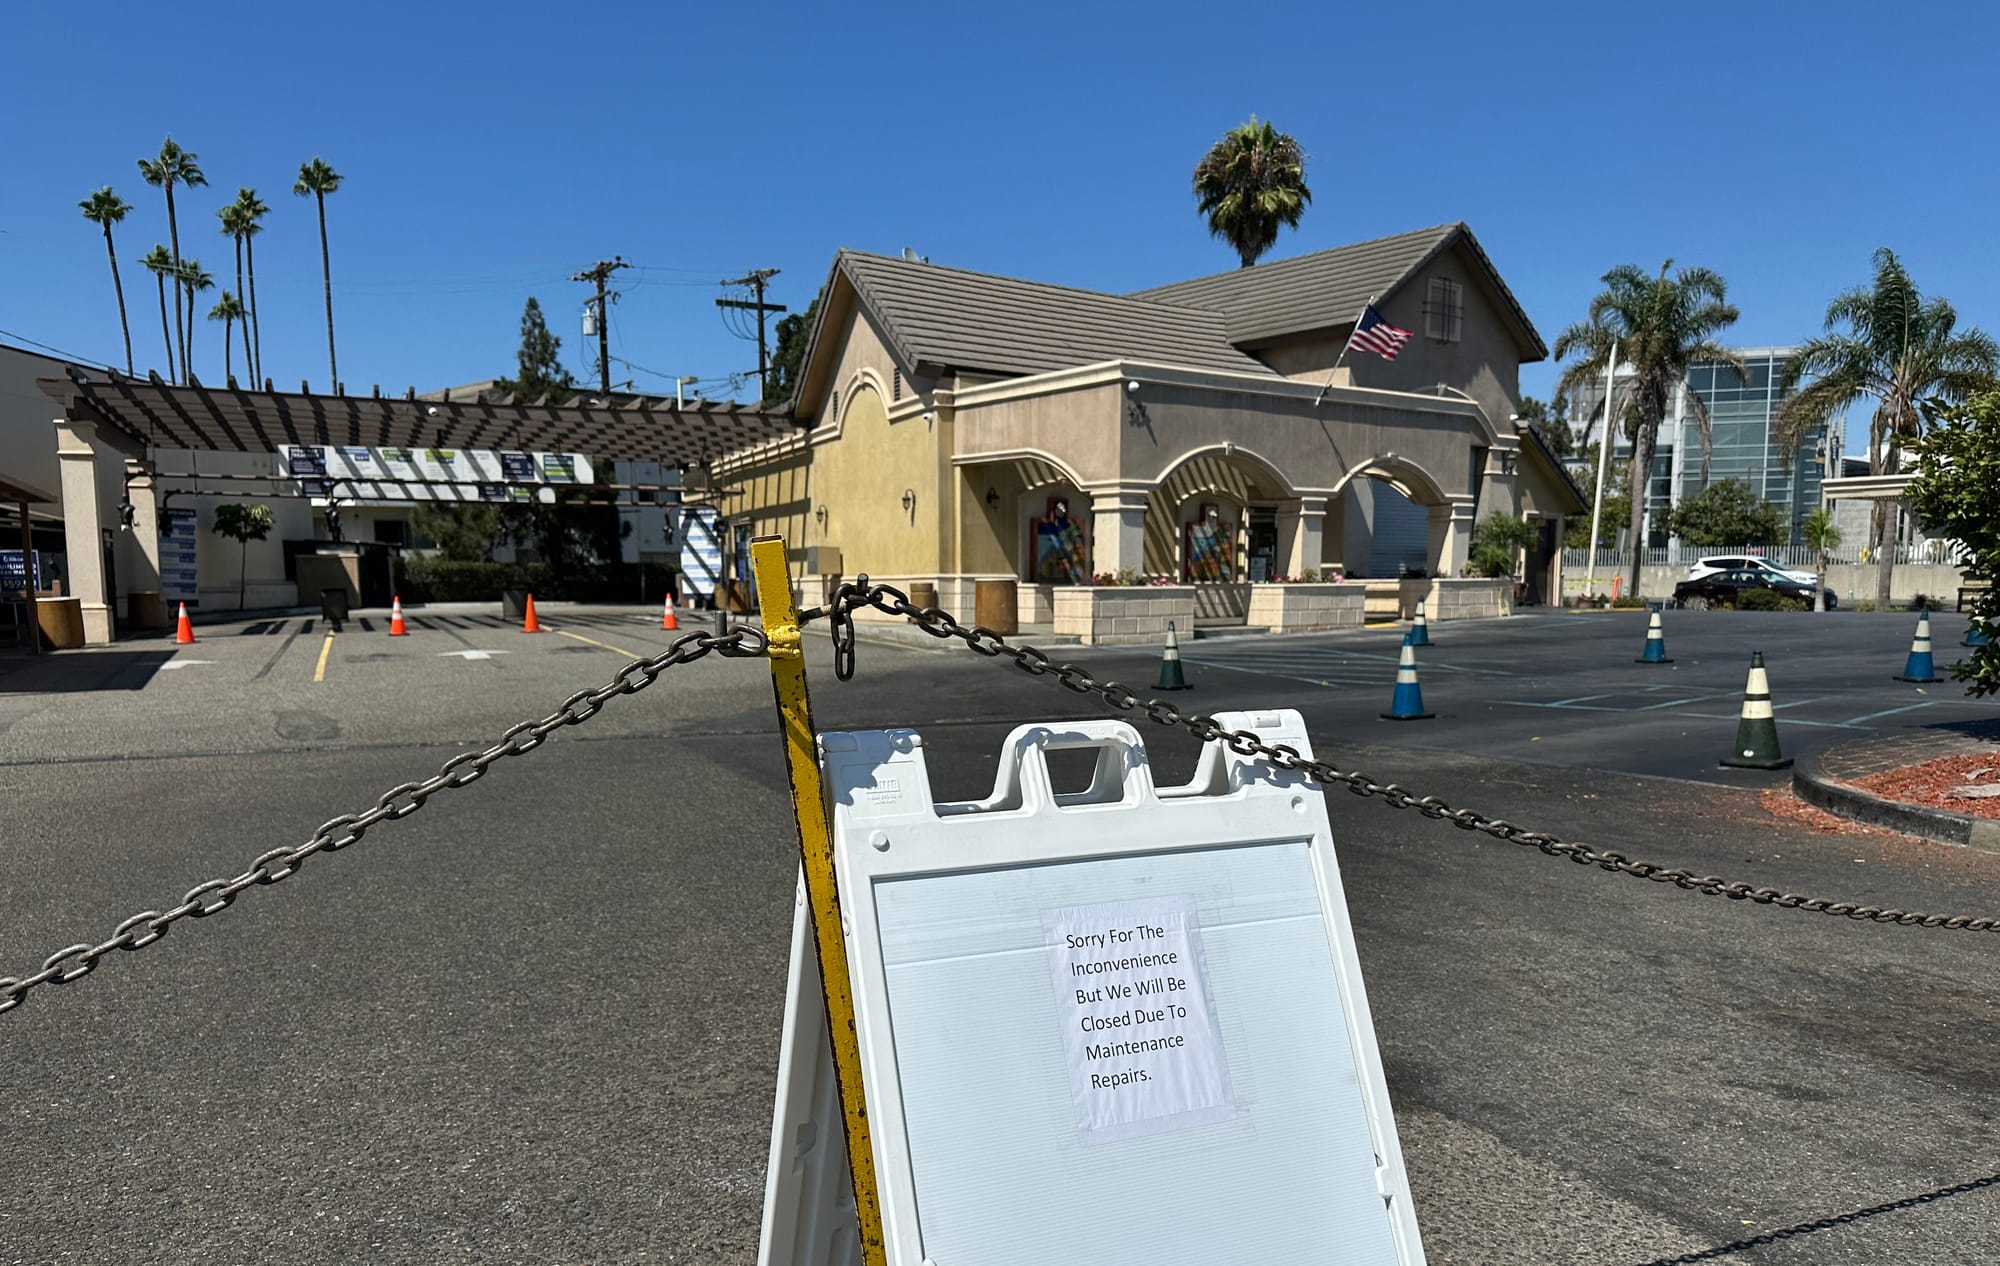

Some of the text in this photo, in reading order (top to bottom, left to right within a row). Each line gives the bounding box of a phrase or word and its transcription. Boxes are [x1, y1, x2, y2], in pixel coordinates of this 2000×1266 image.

[1066, 925, 1164, 949] Sorry For The
[1071, 952, 1178, 976] Inconvenience
[1076, 977, 1186, 1004] But We Will Be
[1081, 1005, 1187, 1032] Closed Due To
[1086, 1035, 1184, 1061] Maintenance
[1091, 1068, 1152, 1090] Repairs.
